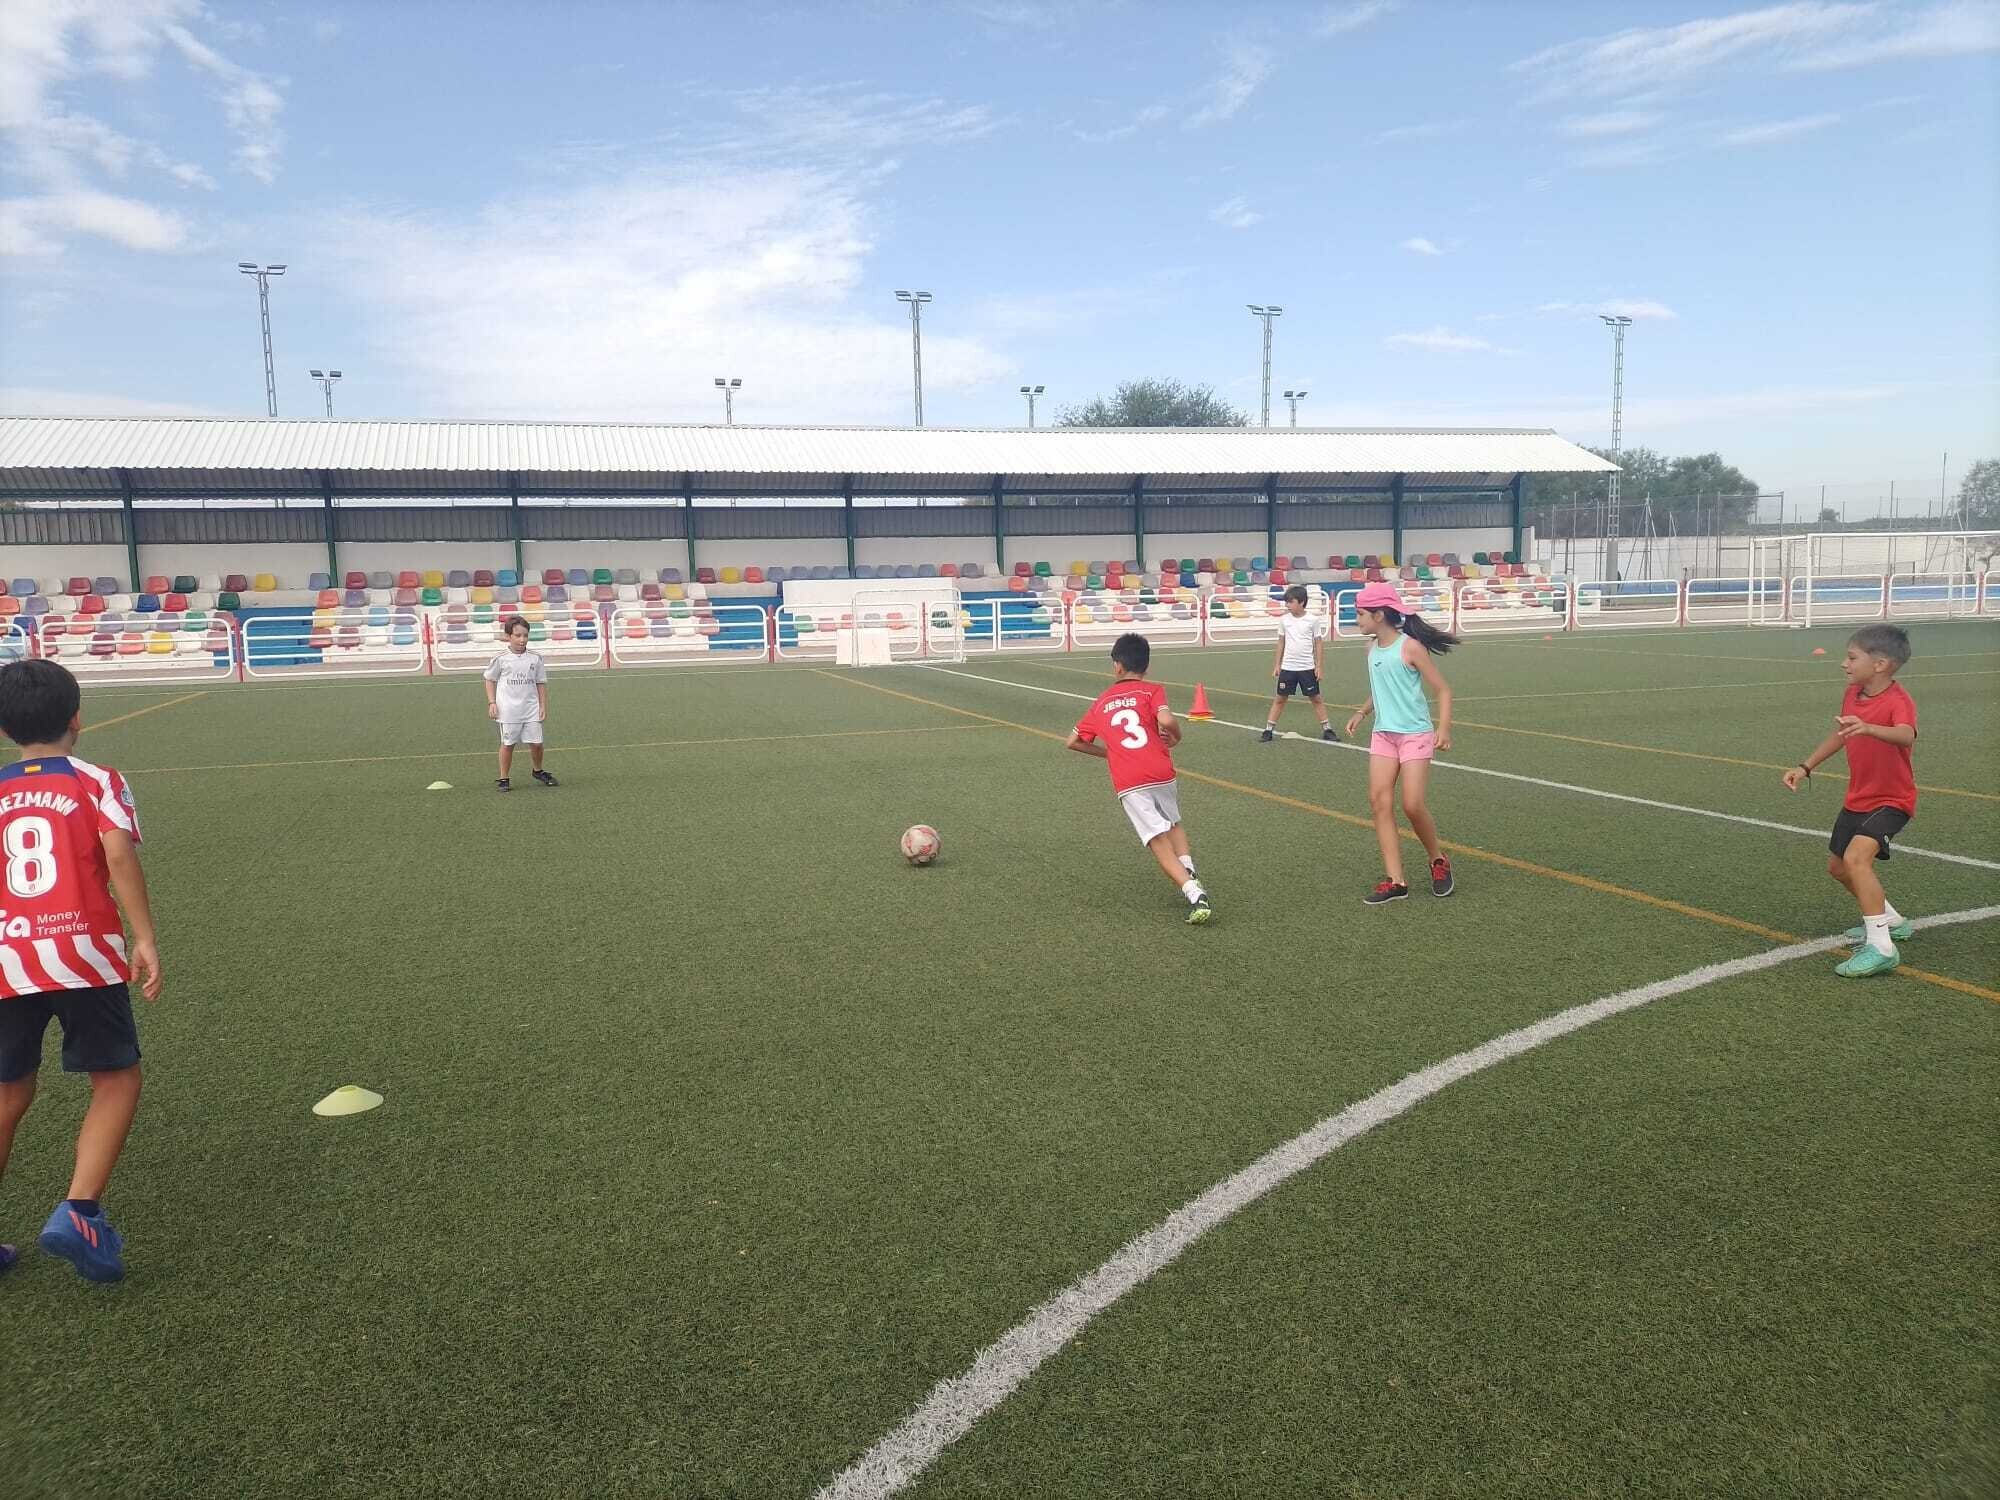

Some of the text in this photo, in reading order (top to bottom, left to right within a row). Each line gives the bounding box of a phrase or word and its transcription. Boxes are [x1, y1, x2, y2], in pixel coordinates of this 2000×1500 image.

[1103, 697, 1137, 714] JESÚS
[1110, 709, 1148, 749] 3
[2, 816, 57, 898] 8
[36, 910, 81, 925] Money
[36, 922, 89, 936] Transfer
